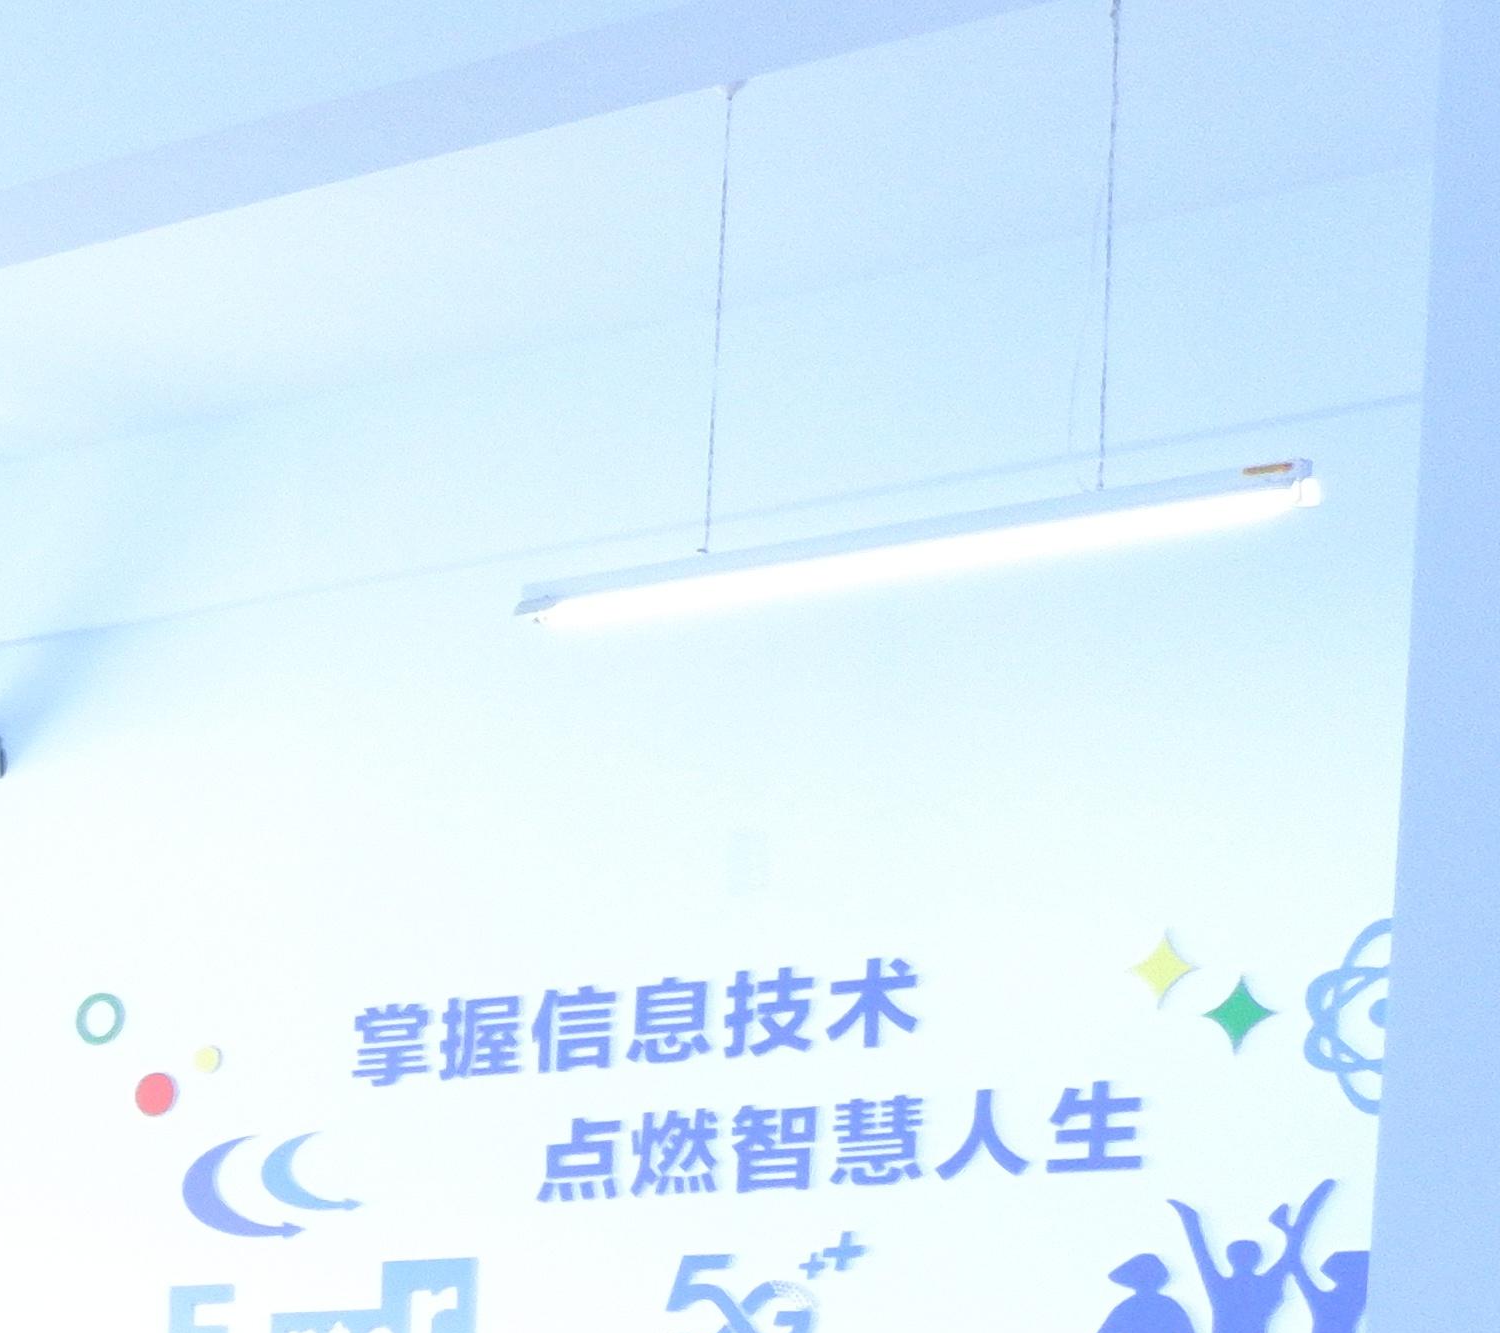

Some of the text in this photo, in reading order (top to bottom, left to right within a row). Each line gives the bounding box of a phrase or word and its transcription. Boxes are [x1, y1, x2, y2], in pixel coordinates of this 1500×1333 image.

[351, 957, 920, 1087] 掌握信息技术
[536, 1081, 1144, 1202] 点燃智慧人生
